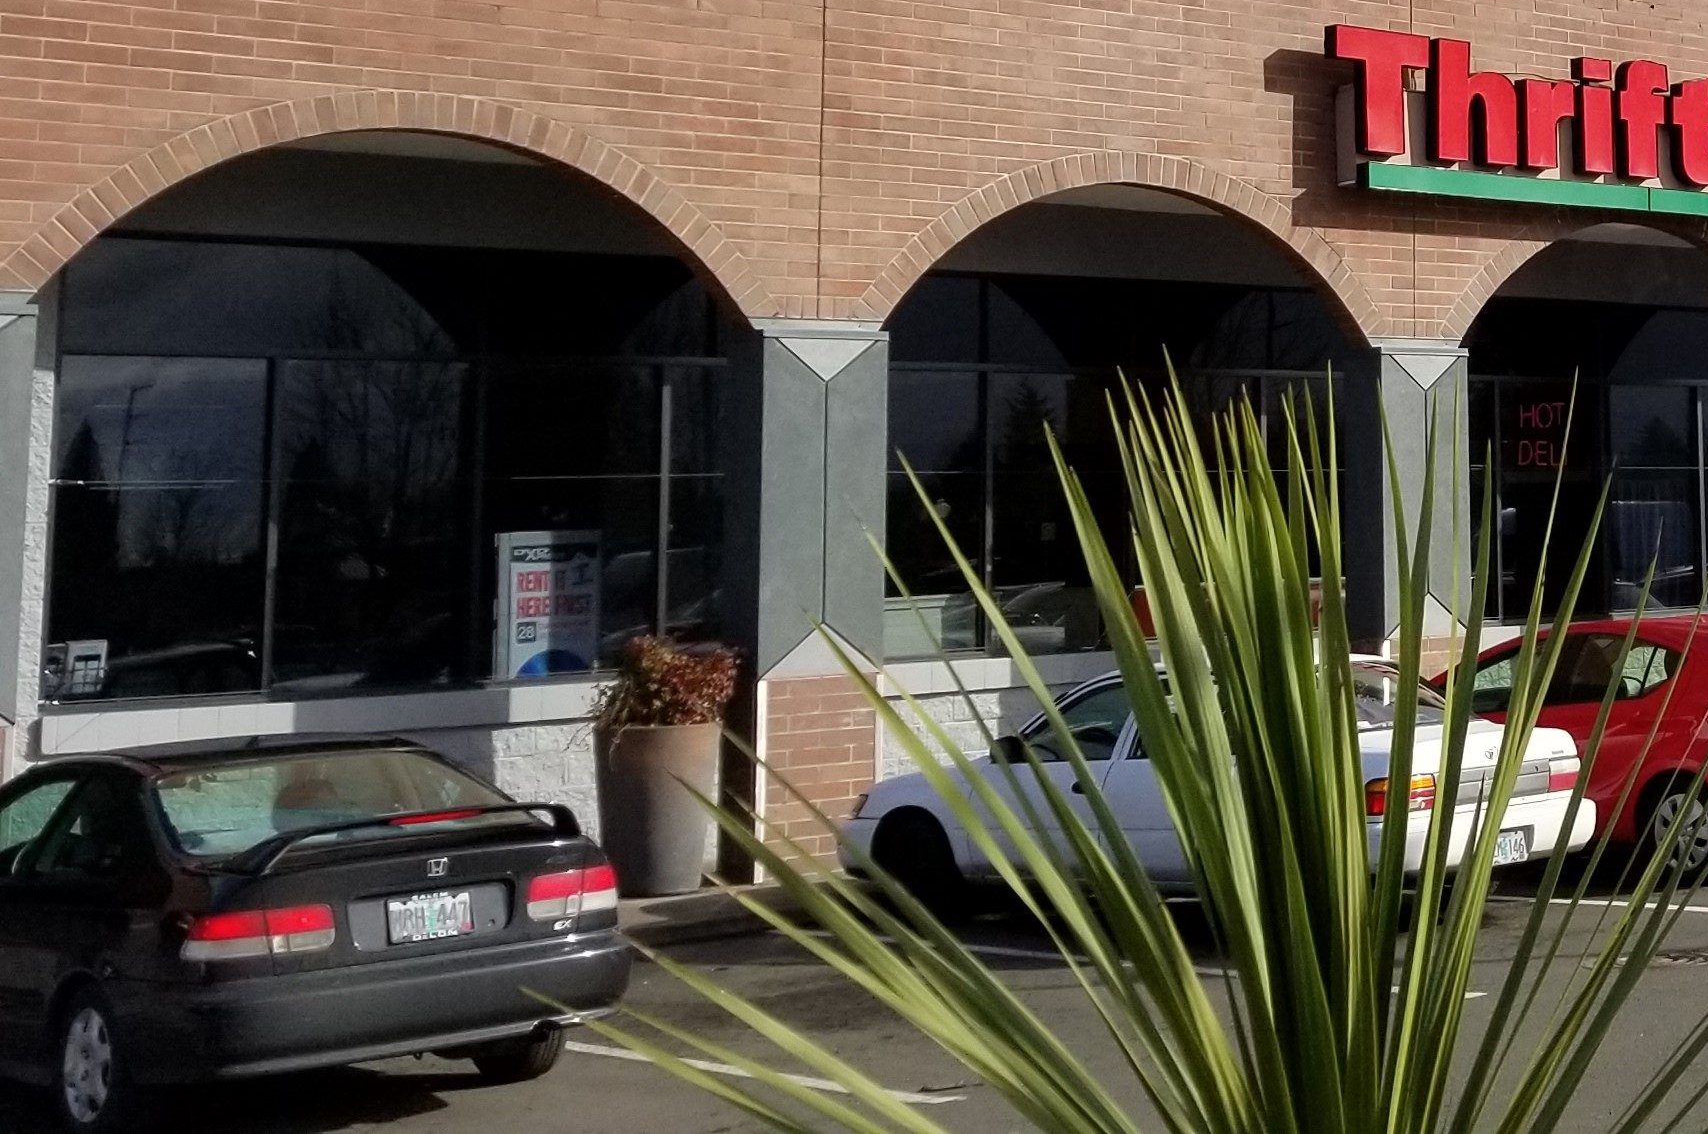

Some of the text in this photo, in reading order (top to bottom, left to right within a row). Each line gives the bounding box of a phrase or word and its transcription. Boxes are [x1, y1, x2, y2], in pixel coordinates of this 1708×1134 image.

[1519, 402, 1566, 428] HOT
[516, 570, 550, 593] RENT
[516, 596, 550, 619] HERE
[517, 625, 536, 639] 28
[1508, 837, 1525, 855] 146
